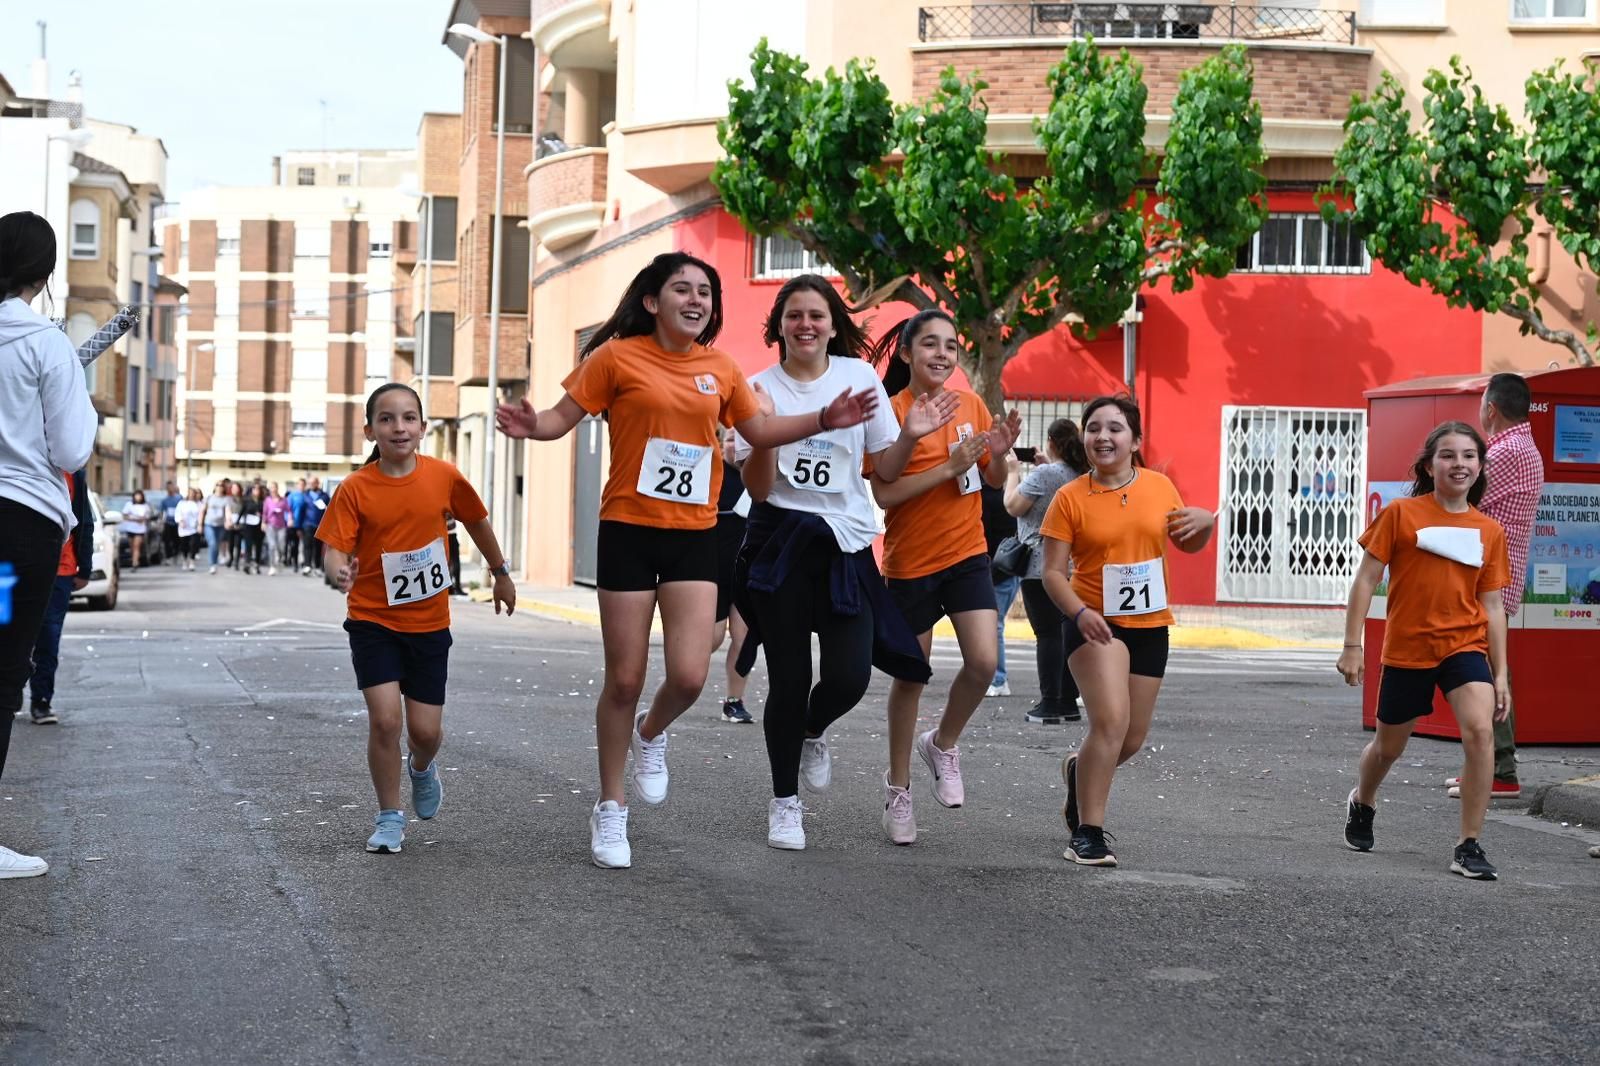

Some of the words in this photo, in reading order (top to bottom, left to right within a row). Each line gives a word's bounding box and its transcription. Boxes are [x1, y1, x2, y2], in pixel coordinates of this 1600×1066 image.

[1528, 402, 1548, 412] 2645
[654, 466, 693, 497] 28
[793, 458, 831, 487] 56
[1553, 495, 1588, 507] SOCIEDAD
[1590, 496, 1600, 507] SA
[1536, 510, 1555, 521] SANA
[1557, 511, 1565, 522] EL
[1536, 525, 1557, 536] DONA.
[391, 562, 444, 600] 218
[1119, 583, 1150, 611] 21
